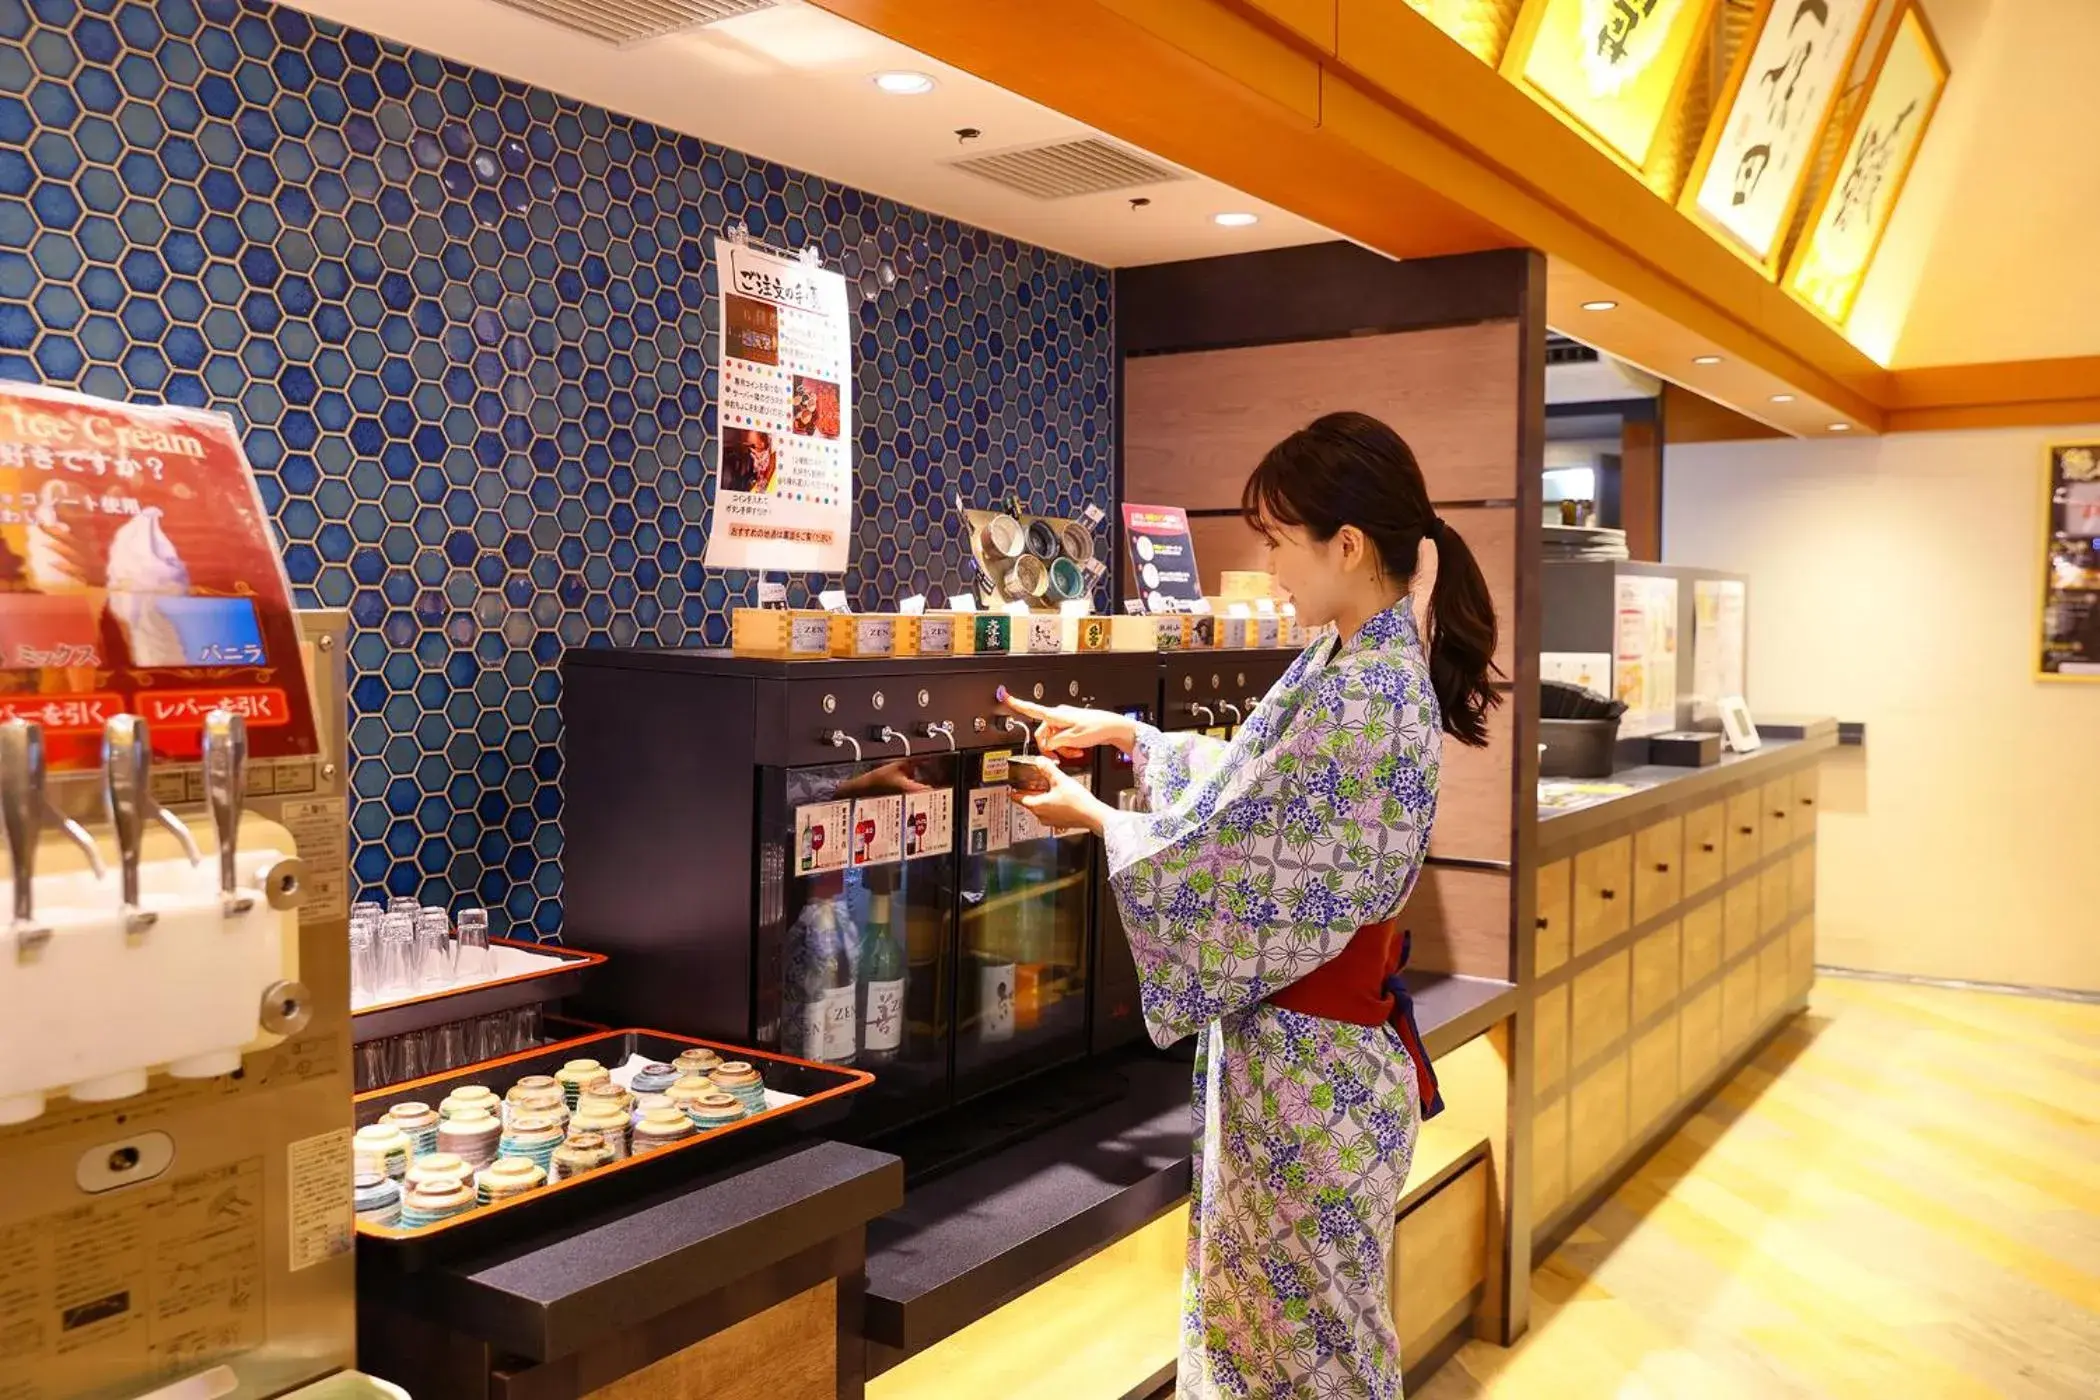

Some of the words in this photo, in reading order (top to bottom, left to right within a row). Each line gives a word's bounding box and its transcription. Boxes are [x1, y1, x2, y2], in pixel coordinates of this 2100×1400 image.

[12, 412, 74, 443] Ice
[83, 414, 205, 459] Cream
[803, 626, 824, 635] ZEN
[201, 643, 265, 663] バニラ
[154, 695, 273, 721] レバーを引く
